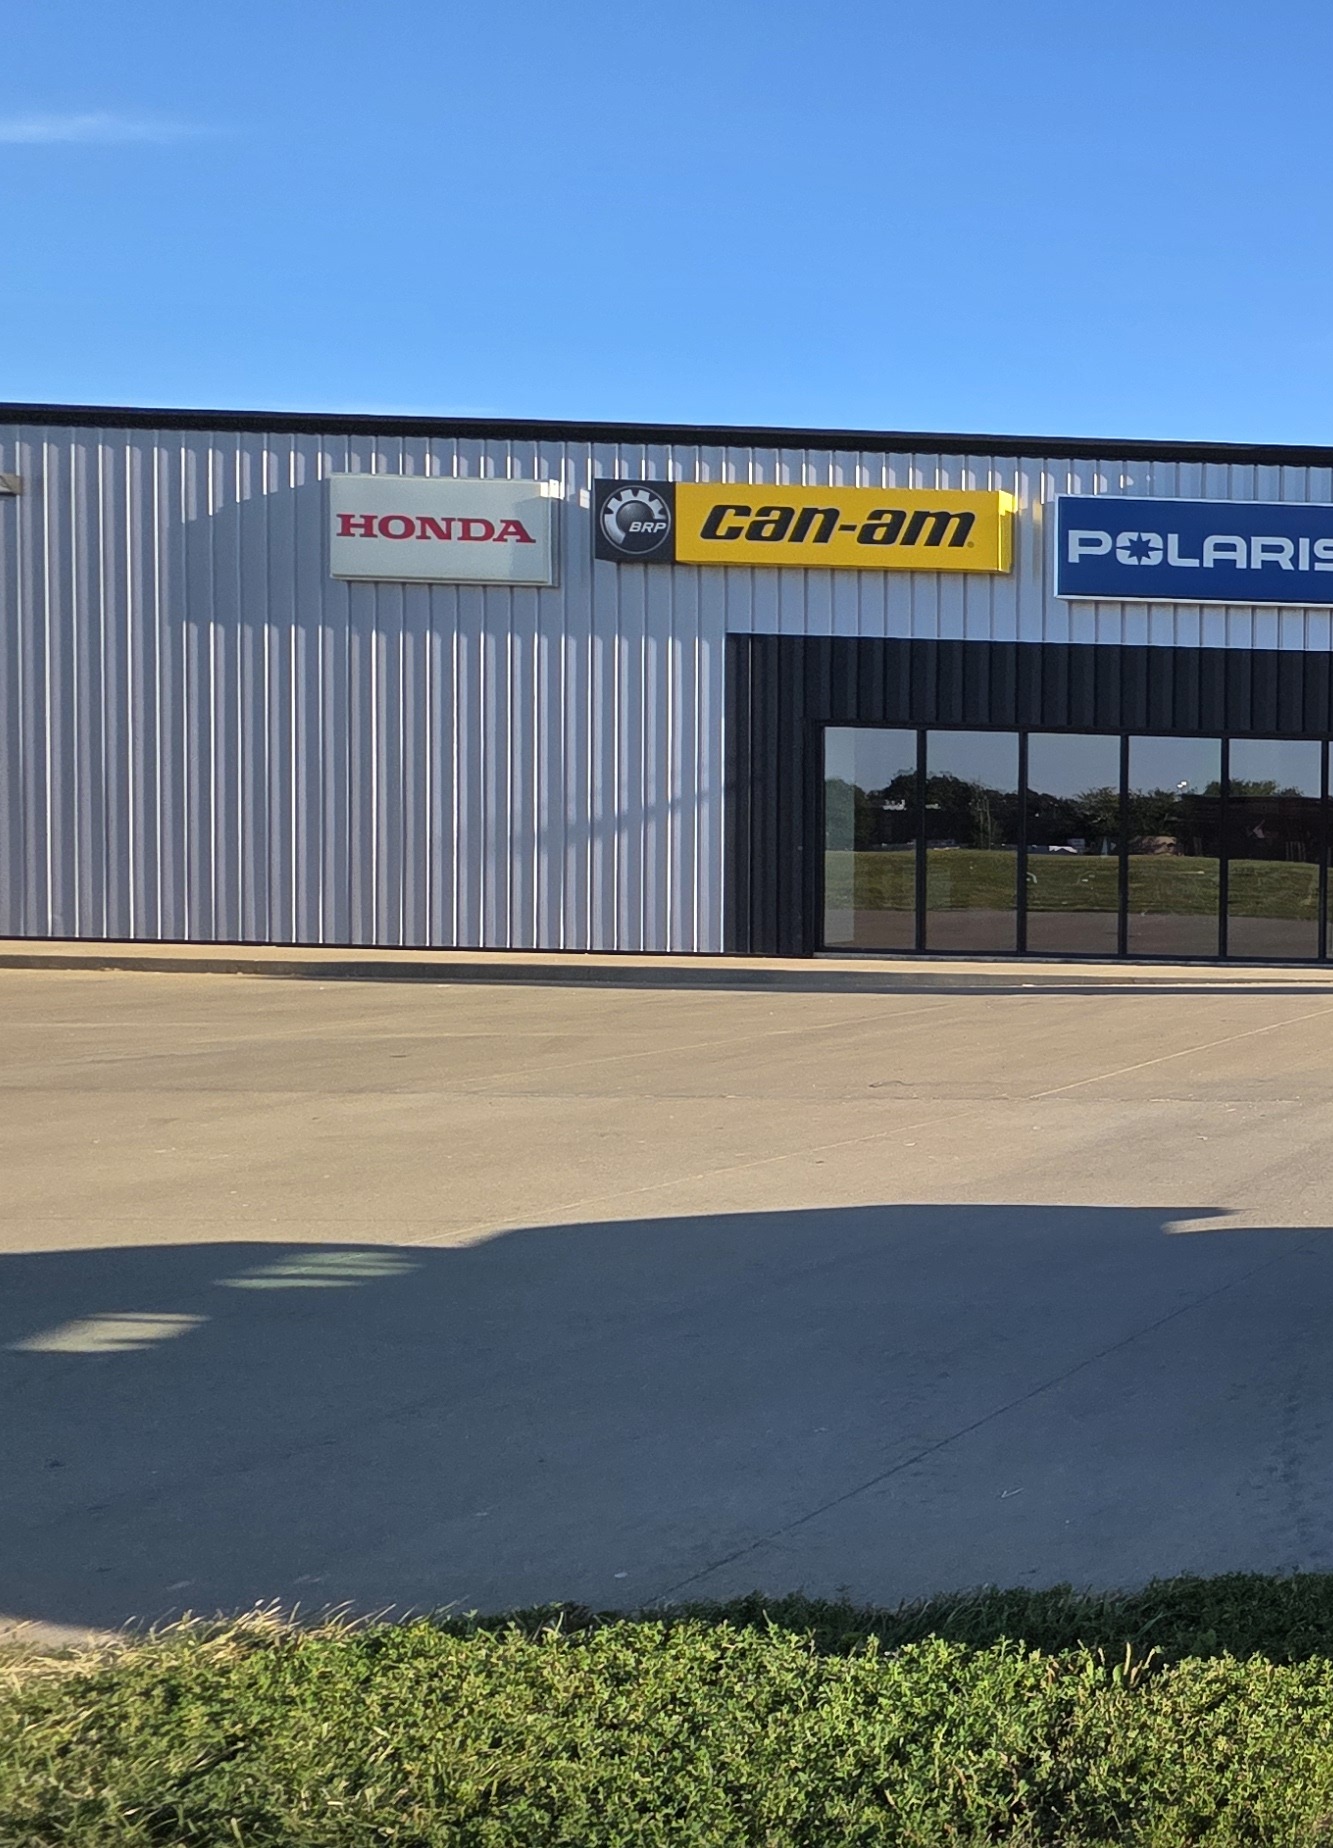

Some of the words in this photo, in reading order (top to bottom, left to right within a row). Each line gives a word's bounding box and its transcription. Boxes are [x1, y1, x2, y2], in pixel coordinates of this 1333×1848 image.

[336, 513, 537, 544] HONDA
[629, 521, 667, 533] BRP
[700, 504, 976, 548] can-am
